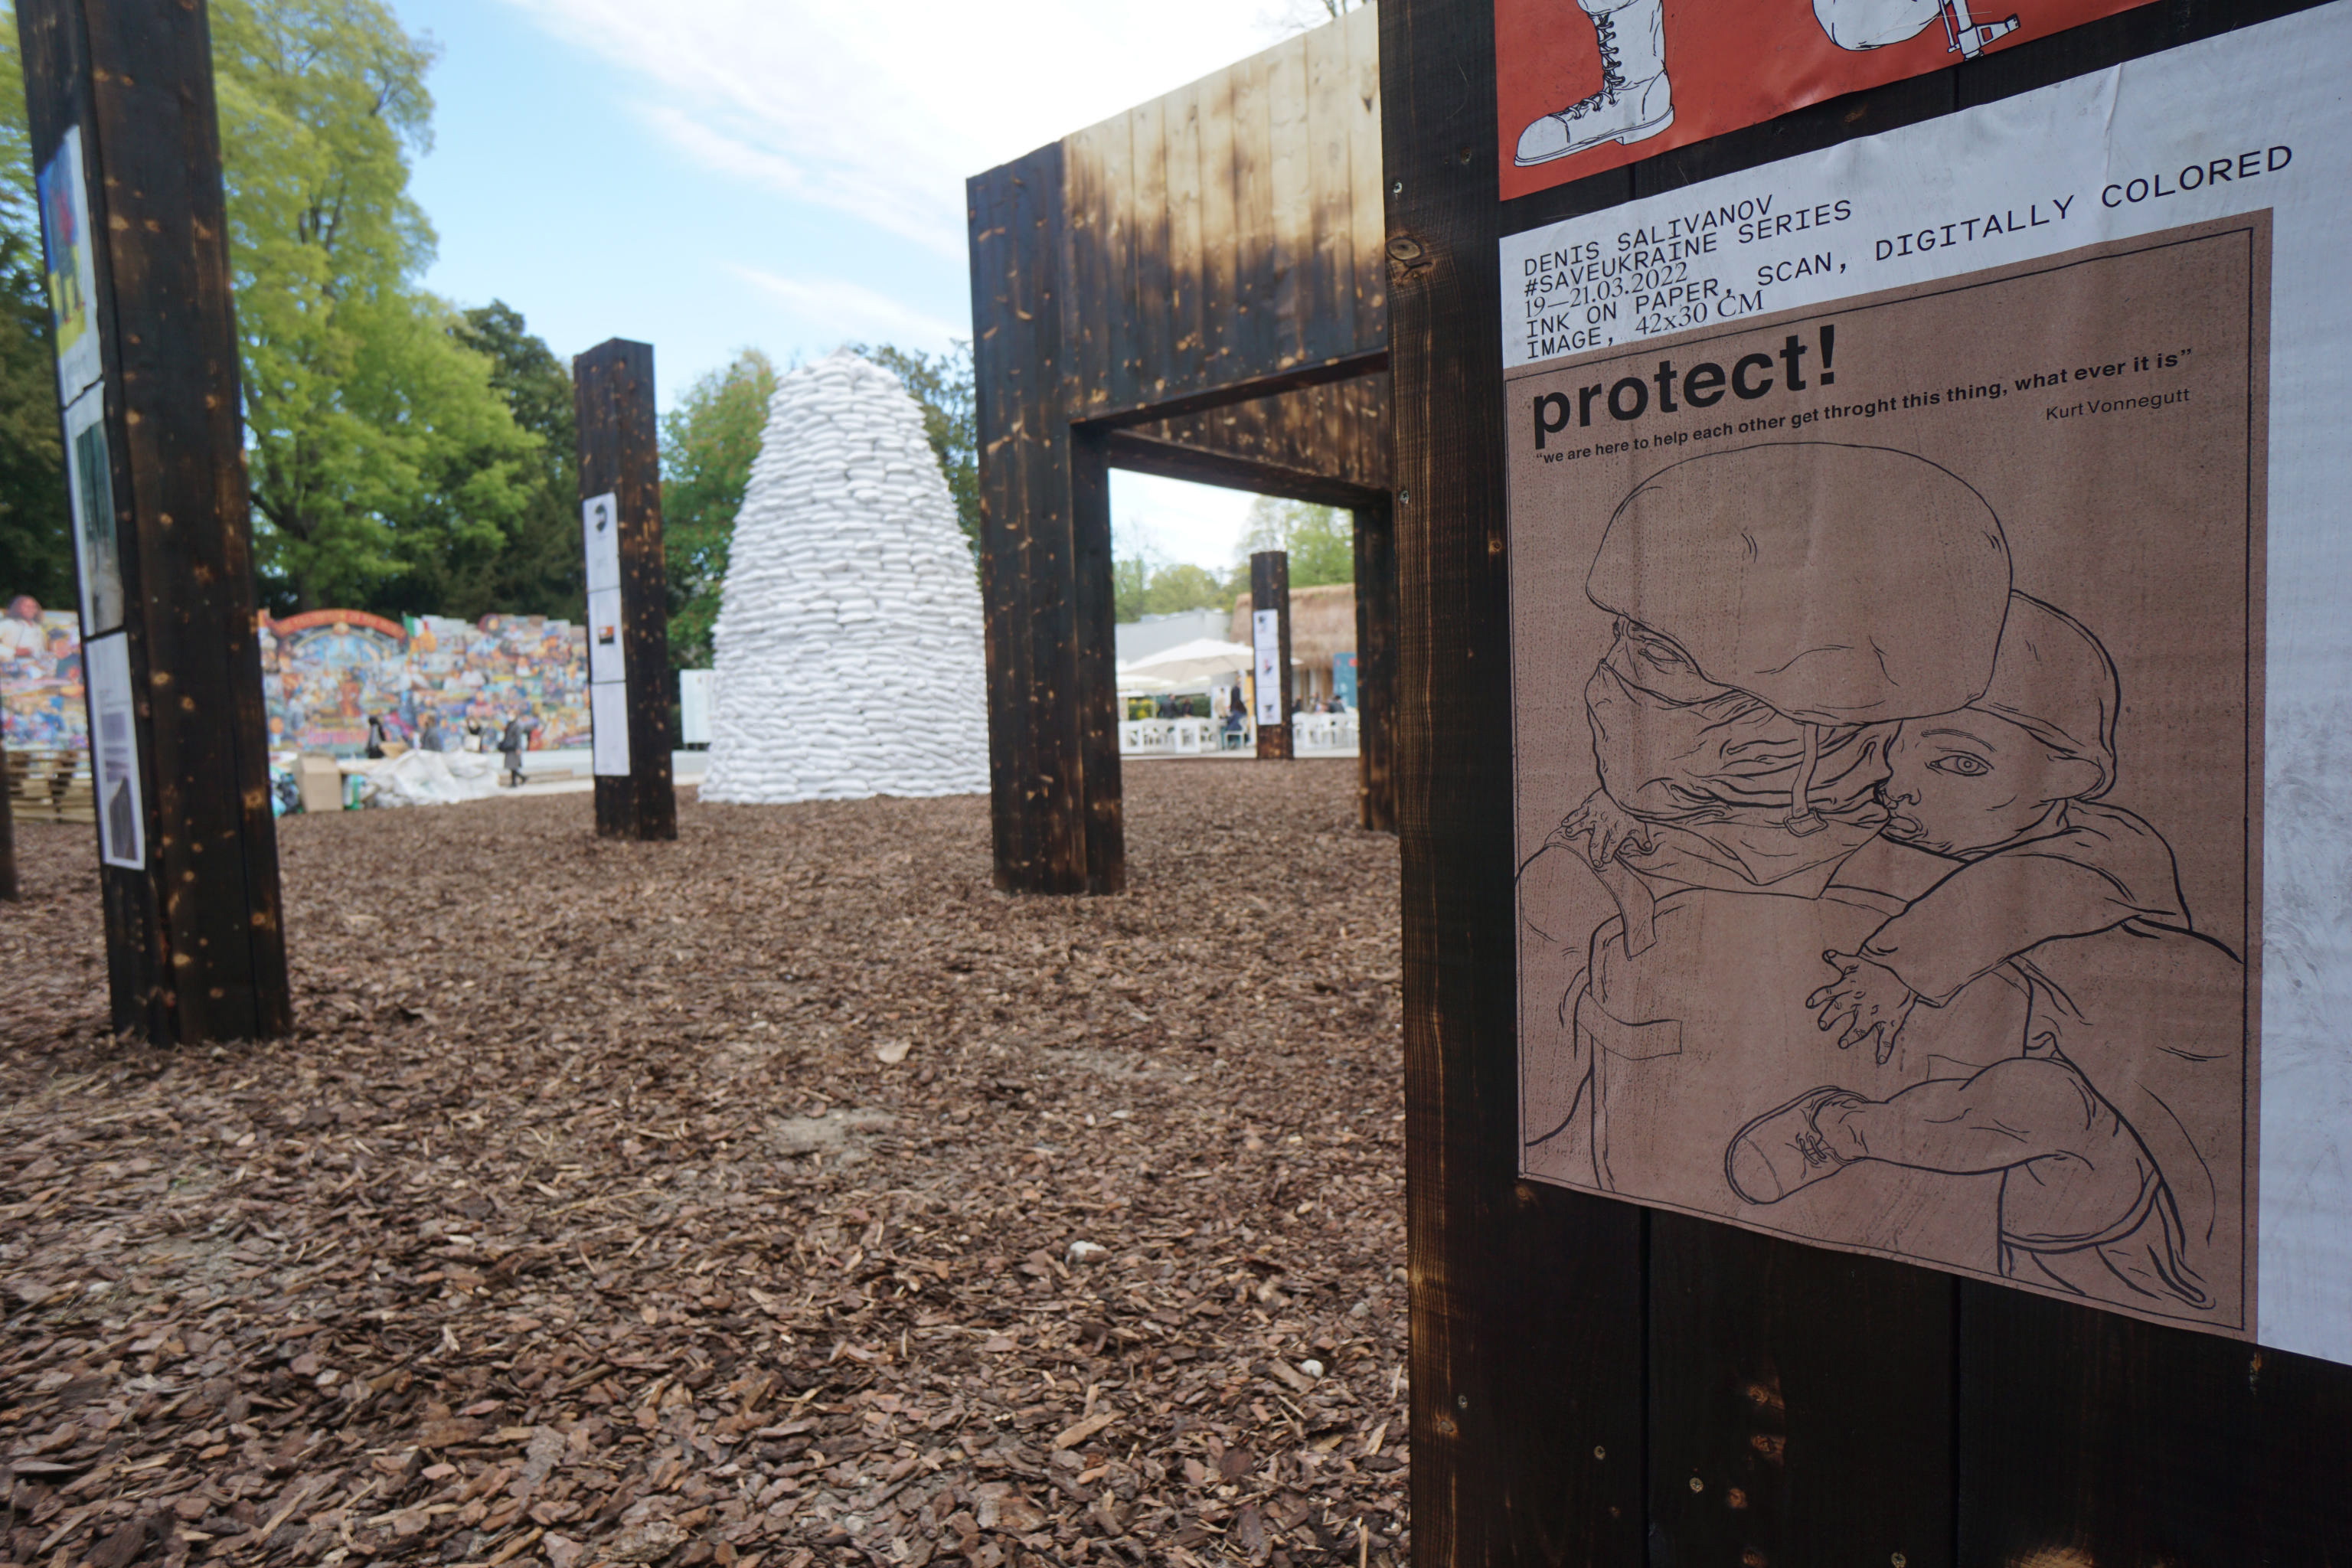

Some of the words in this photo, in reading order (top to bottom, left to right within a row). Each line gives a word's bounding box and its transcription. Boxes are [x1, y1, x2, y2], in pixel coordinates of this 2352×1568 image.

[1524, 241, 1599, 276] DENIS
[1618, 194, 1772, 252] SALIVANOV
[1524, 232, 1717, 296] #SAVEUKRAINE
[1738, 200, 1851, 244] SERIES
[1527, 312, 1569, 338] INK
[1586, 302, 1617, 325] ON
[1635, 278, 1733, 314] PAPER,
[1758, 252, 1846, 286] SCAN,
[1876, 194, 2074, 261] DIGITALLY
[2101, 145, 2292, 207] COLORED
[1527, 327, 1614, 359] IMAGE,
[1635, 302, 1707, 335] 42x30
[1717, 289, 1764, 318] CM
[1533, 324, 1835, 450] protect!
[1567, 446, 1591, 459] are
[1595, 441, 1628, 456] here
[1634, 437, 1648, 449] to
[1654, 431, 1688, 449] help
[1693, 423, 1733, 440] each
[1739, 416, 1785, 433] other
[1791, 410, 1819, 428] get
[1824, 397, 1896, 420] throght
[1903, 391, 1940, 410] this
[1947, 382, 2008, 402] thing,
[2014, 368, 2067, 390] what
[2074, 361, 2125, 381] ever
[2133, 357, 2149, 372] it
[2046, 403, 2083, 420] Kurt
[2087, 388, 2190, 415] Vonnegutt
